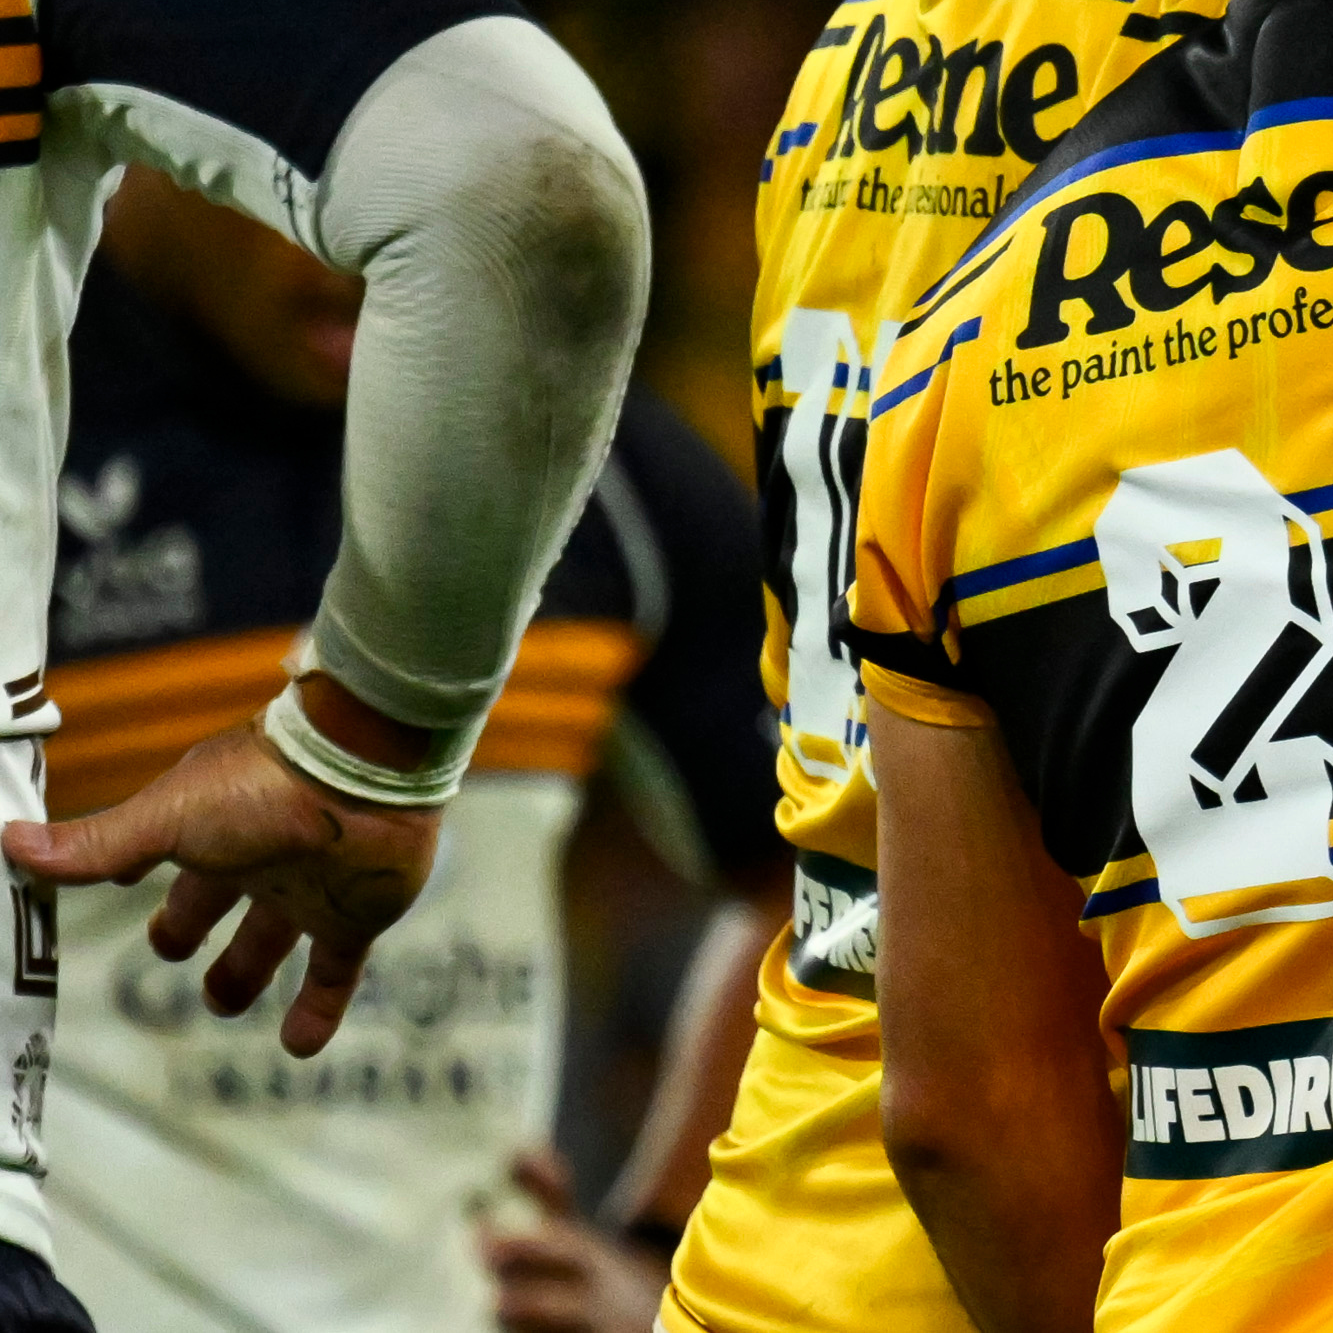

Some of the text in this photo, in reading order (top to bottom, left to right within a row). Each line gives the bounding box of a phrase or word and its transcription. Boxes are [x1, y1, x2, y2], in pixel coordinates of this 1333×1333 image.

[989, 359, 1052, 407] the
[1061, 337, 1157, 400] paint
[1165, 317, 1218, 368] the
